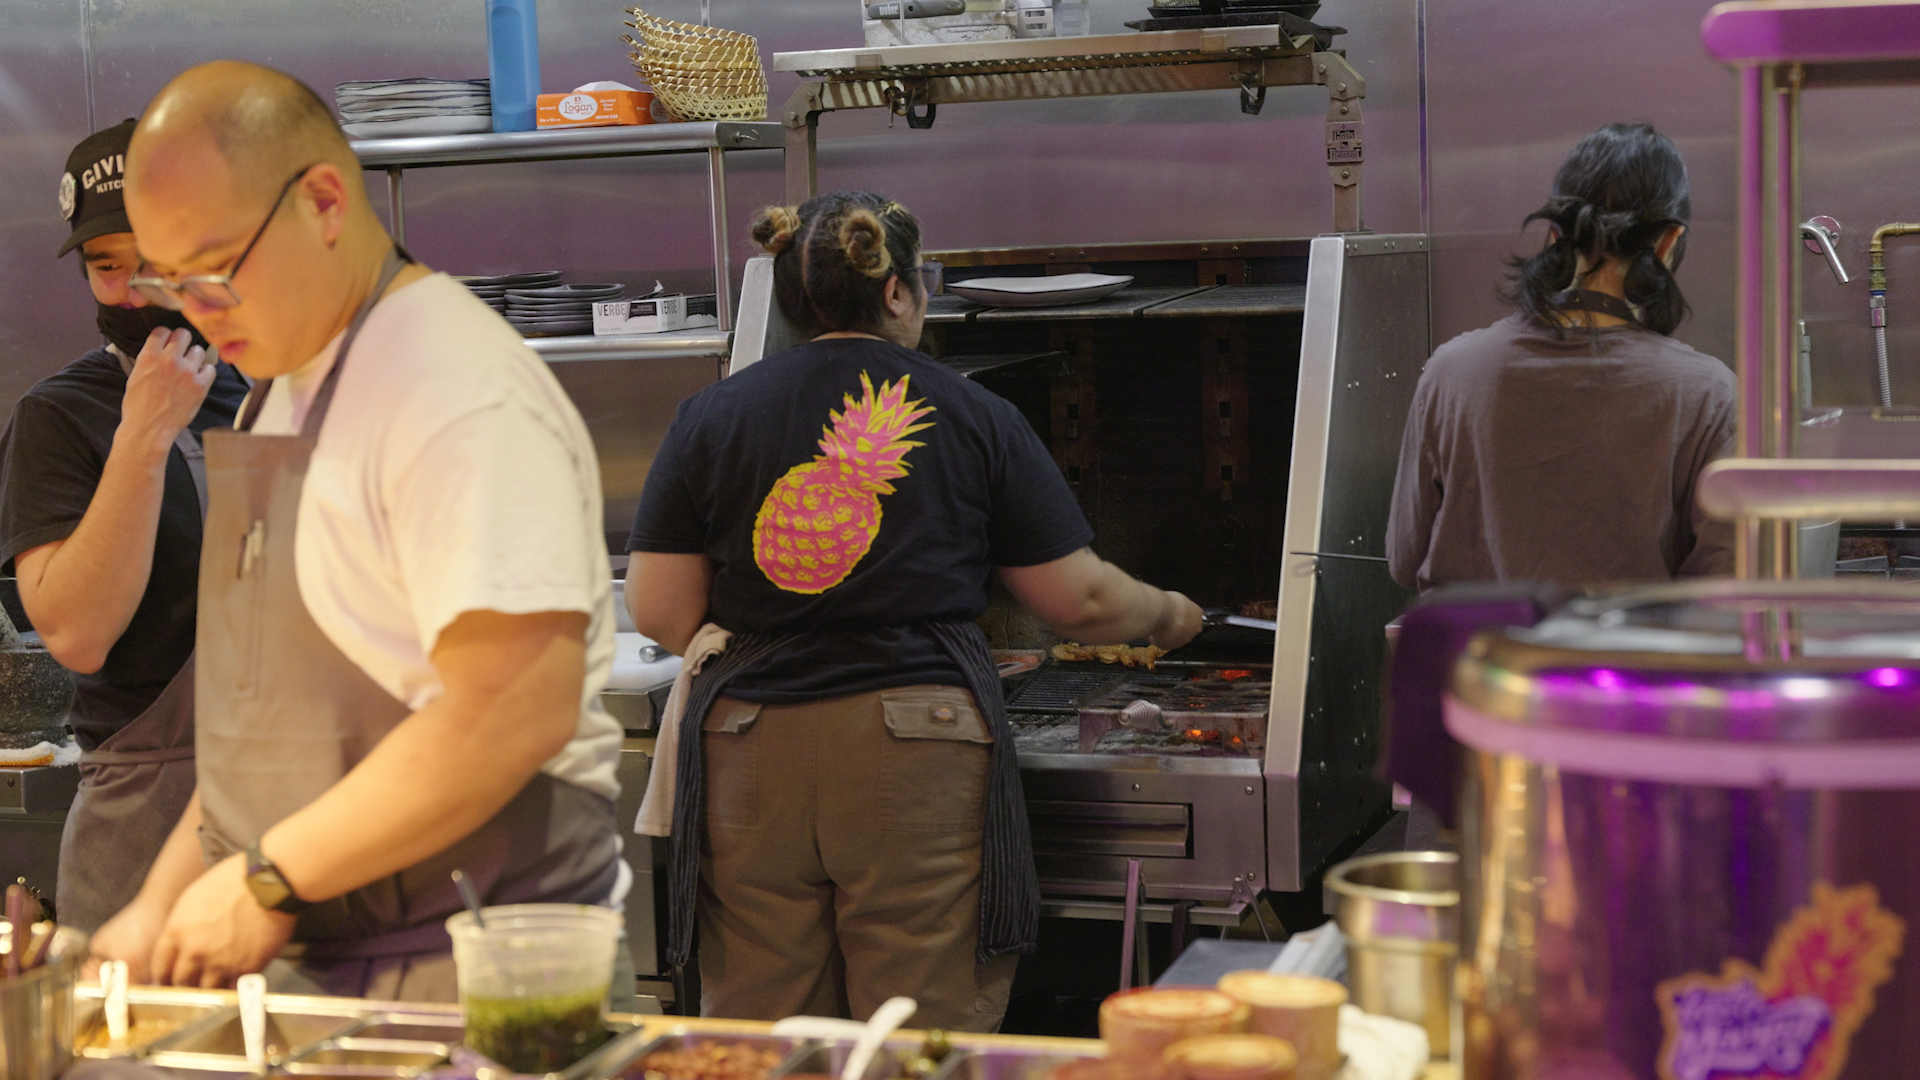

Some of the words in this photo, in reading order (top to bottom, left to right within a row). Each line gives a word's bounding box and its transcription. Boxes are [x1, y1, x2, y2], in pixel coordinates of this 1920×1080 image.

[564, 101, 594, 115] Logan
[597, 303, 626, 316] VERGE
[660, 299, 678, 315] VERGE
